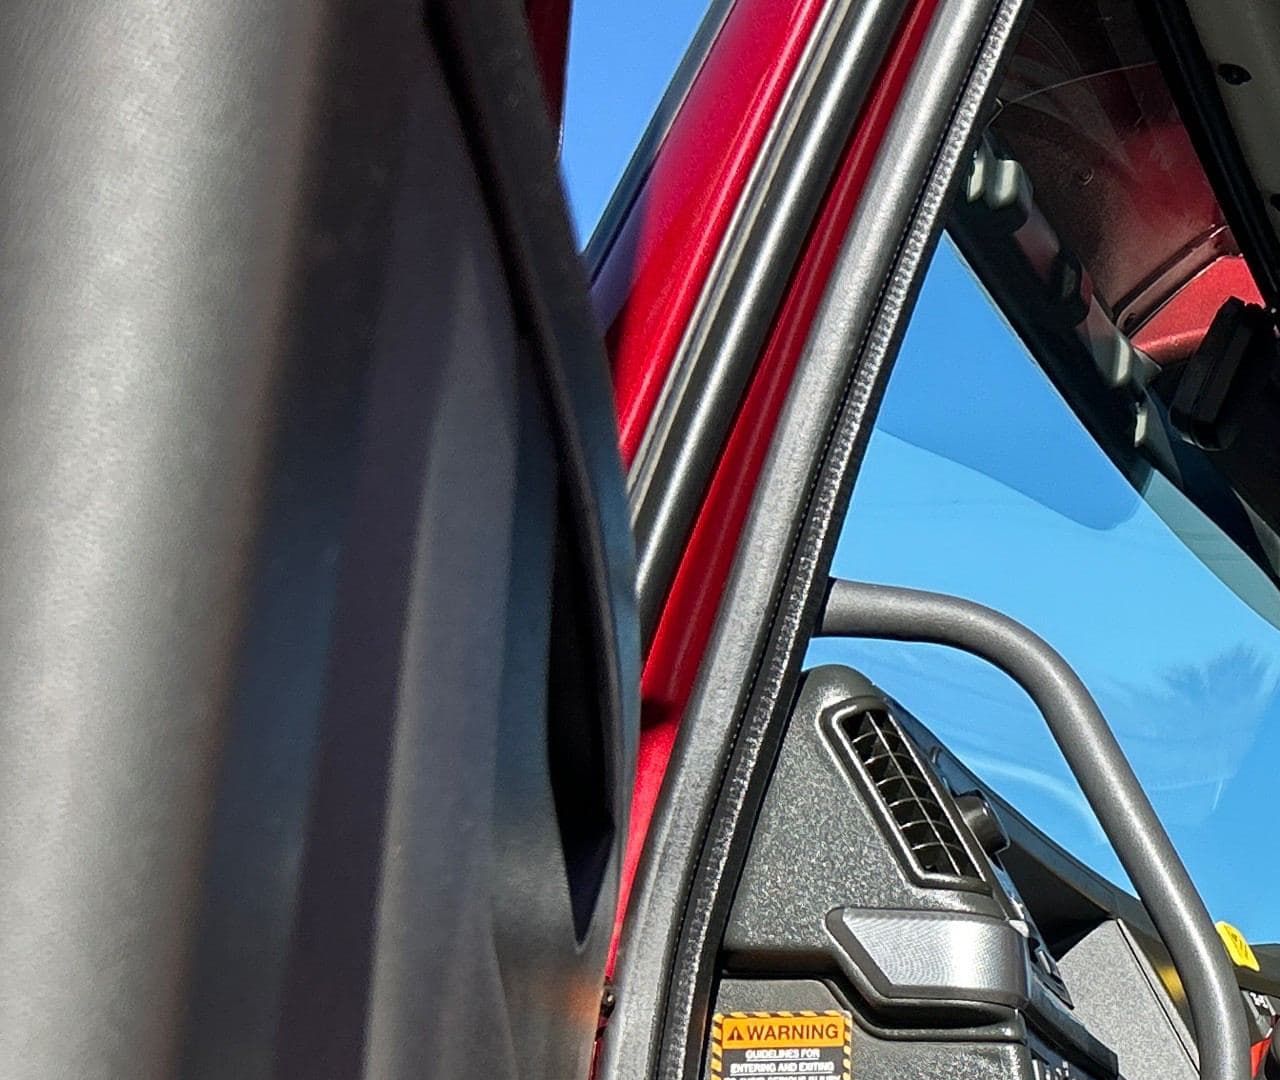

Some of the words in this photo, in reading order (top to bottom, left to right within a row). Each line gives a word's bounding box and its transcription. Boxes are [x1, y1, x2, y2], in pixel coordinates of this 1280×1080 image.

[747, 1023, 839, 1040] WARNING
[745, 1049, 799, 1059] GUIDELINES
[801, 1048, 820, 1058] FOR
[730, 1062, 776, 1073] ENTERING
[778, 1062, 797, 1072] AND
[799, 1061, 834, 1072] EXITING
